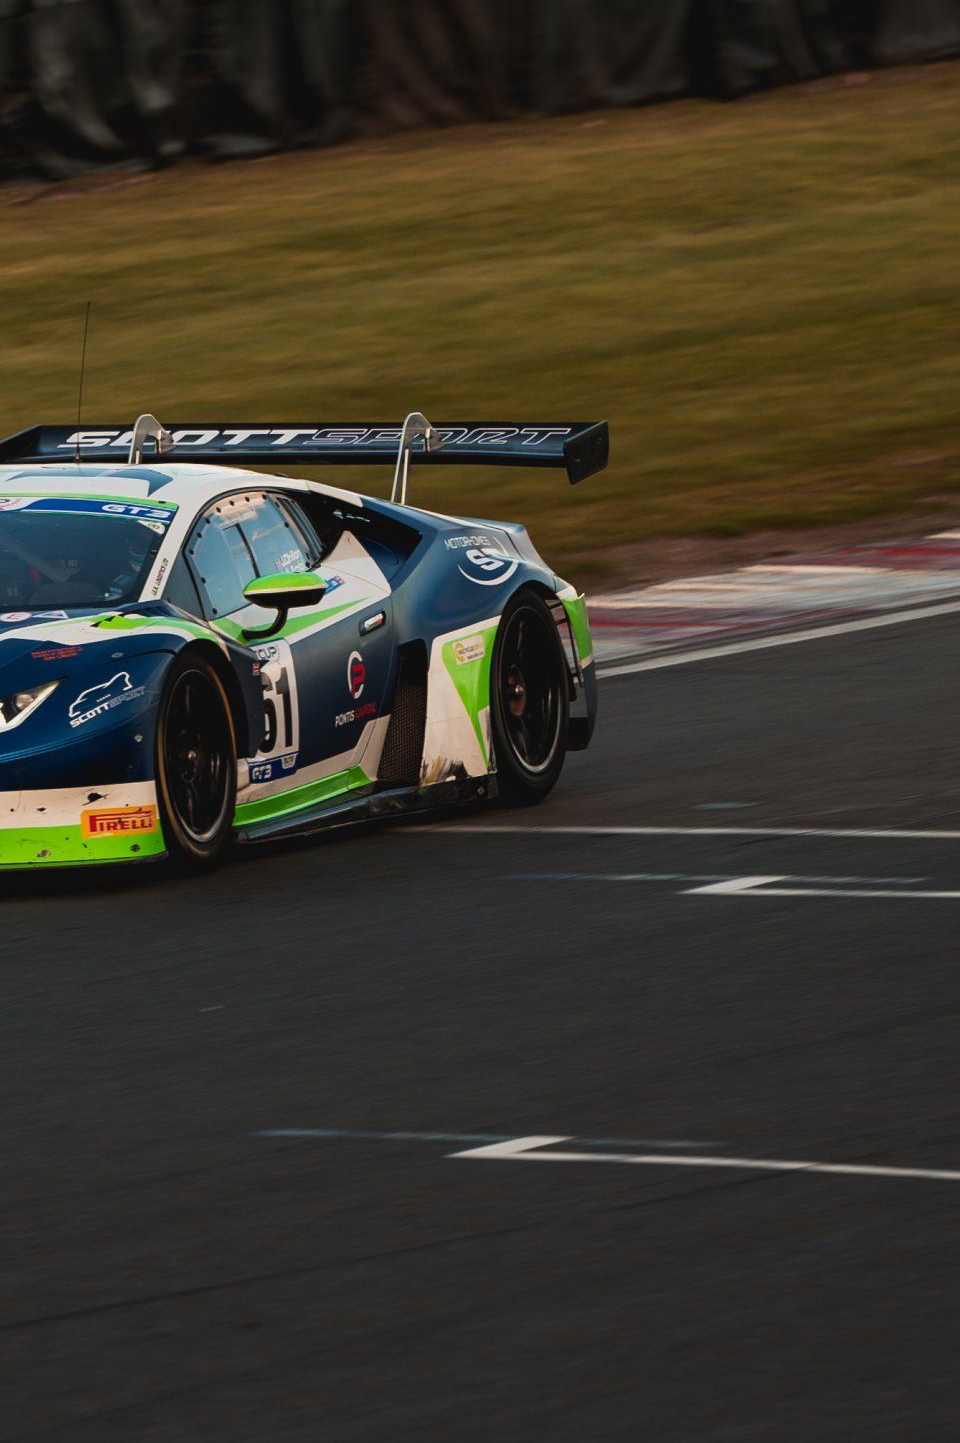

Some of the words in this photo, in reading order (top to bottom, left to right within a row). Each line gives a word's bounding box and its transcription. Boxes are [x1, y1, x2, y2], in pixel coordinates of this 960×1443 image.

[101, 504, 171, 518] GT3
[252, 764, 272, 780] GT3
[88, 808, 153, 833] PIRELLI
